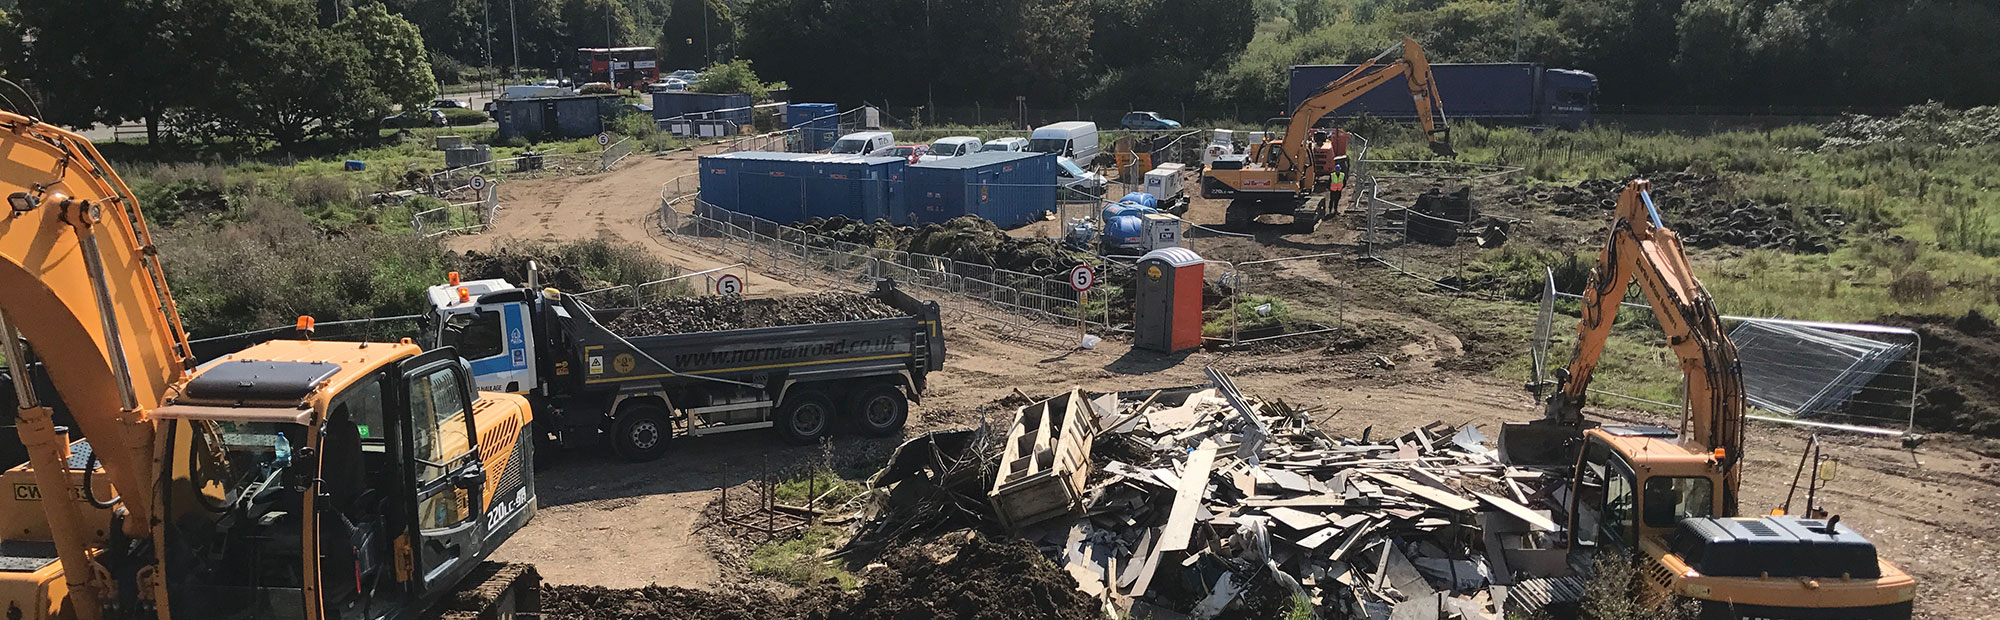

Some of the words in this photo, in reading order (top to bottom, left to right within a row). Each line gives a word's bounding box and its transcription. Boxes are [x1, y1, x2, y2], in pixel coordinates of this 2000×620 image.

[474, 178, 481, 187] 5
[1077, 271, 1087, 286] 5
[725, 280, 735, 294] 5
[675, 335, 897, 368] www.normanroad.co.uk
